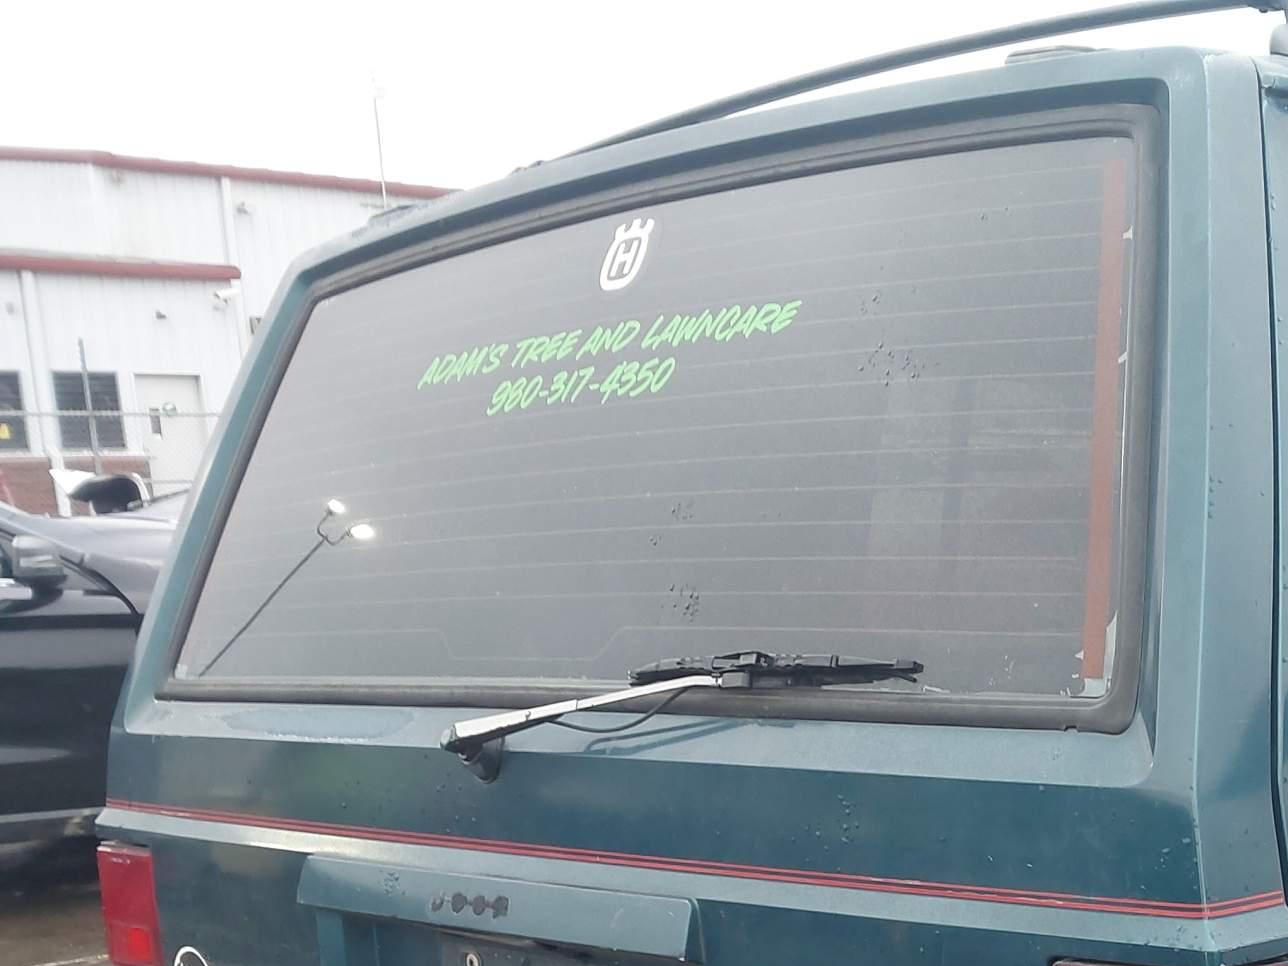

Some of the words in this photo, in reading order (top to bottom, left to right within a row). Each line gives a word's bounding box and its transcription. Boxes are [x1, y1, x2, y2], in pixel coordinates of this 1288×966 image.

[417, 343, 509, 390] ADAM'S
[511, 329, 583, 369] TREE
[575, 319, 641, 361] AND
[641, 299, 803, 350] LAWNCARE
[486, 356, 676, 416] 980-317-4350
